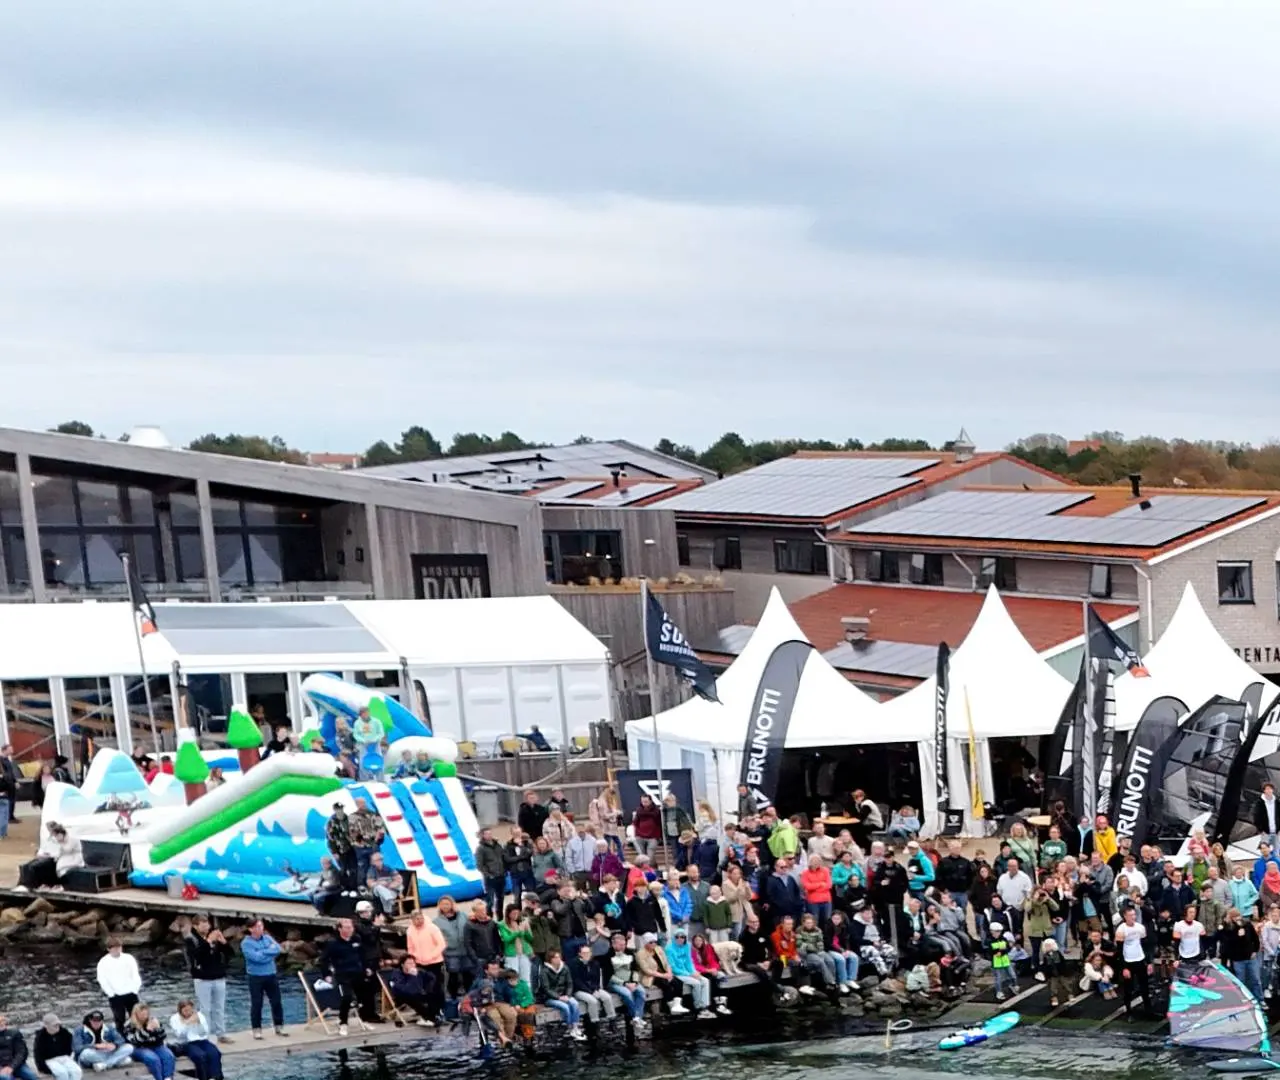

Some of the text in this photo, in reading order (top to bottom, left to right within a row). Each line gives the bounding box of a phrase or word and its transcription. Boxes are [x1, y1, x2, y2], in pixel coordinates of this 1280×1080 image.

[422, 577, 482, 599] DAM
[747, 688, 782, 785] BRUNOTTI
[1115, 746, 1154, 840] RUNOTTI
